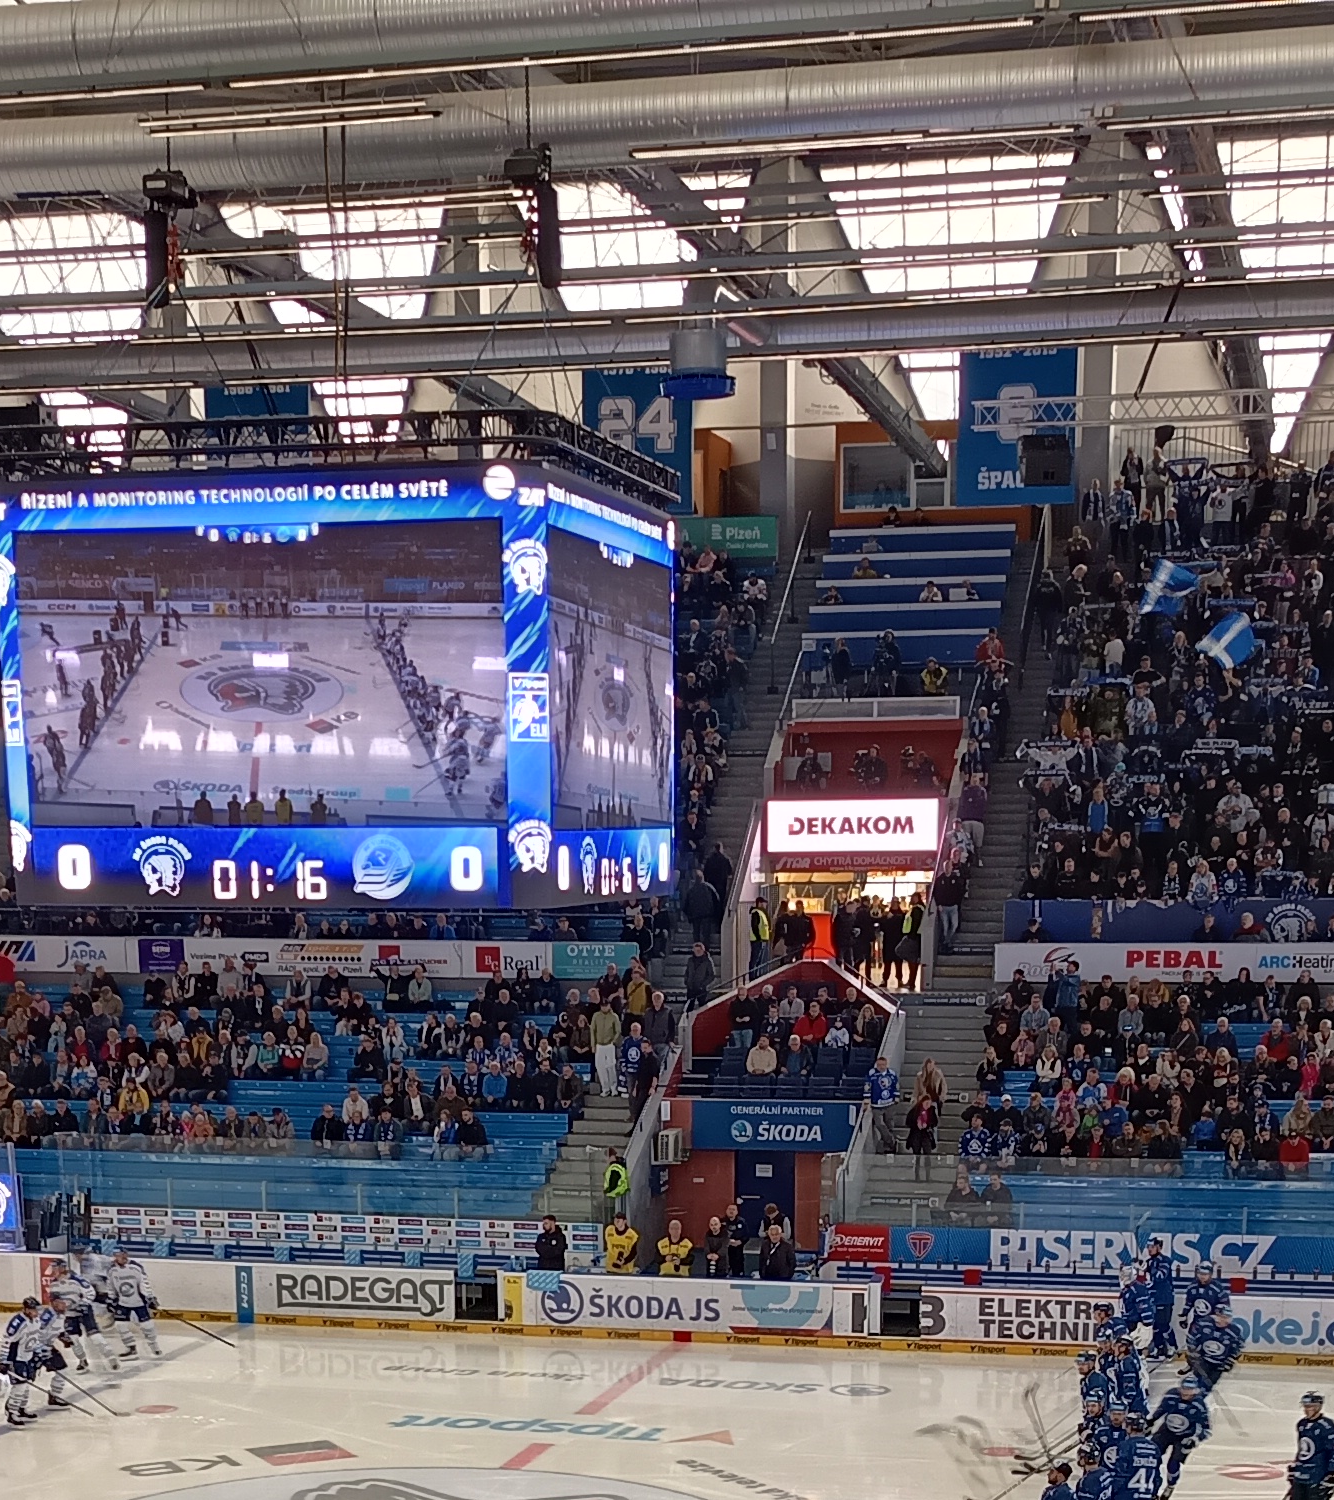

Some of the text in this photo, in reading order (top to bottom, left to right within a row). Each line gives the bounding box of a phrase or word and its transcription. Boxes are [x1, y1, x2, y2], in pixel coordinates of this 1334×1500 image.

[598, 397, 677, 454] 24
[21, 479, 448, 511] ŘÍZENÍ A MONITORING TECHNOLOGIÍ PO CELÉM SVĚTĚ
[518, 488, 545, 507] ZAT
[725, 526, 760, 540] Plzeň
[788, 816, 914, 836] DEKAKOM
[57, 843, 92, 890] 0
[450, 845, 484, 892] 0
[813, 855, 851, 866] CHYTRÁ
[853, 854, 912, 866] DOMÁCNOST
[503, 955, 541, 971] Real
[567, 945, 615, 958] OTTE
[1125, 950, 1222, 969] PEBAL
[731, 1104, 823, 1116] GENERÁLNÍ PARTNER
[757, 1121, 822, 1141] ŠKODA
[238, 1271, 249, 1310] CCM
[275, 1273, 453, 1317] RADEGAST
[589, 1288, 720, 1322] ŠKODA JS
[979, 1320, 1098, 1342] TECHNI
[389, 1414, 665, 1443] Tipsport
[120, 1453, 243, 1479] KB
[676, 1458, 766, 1490] televize
